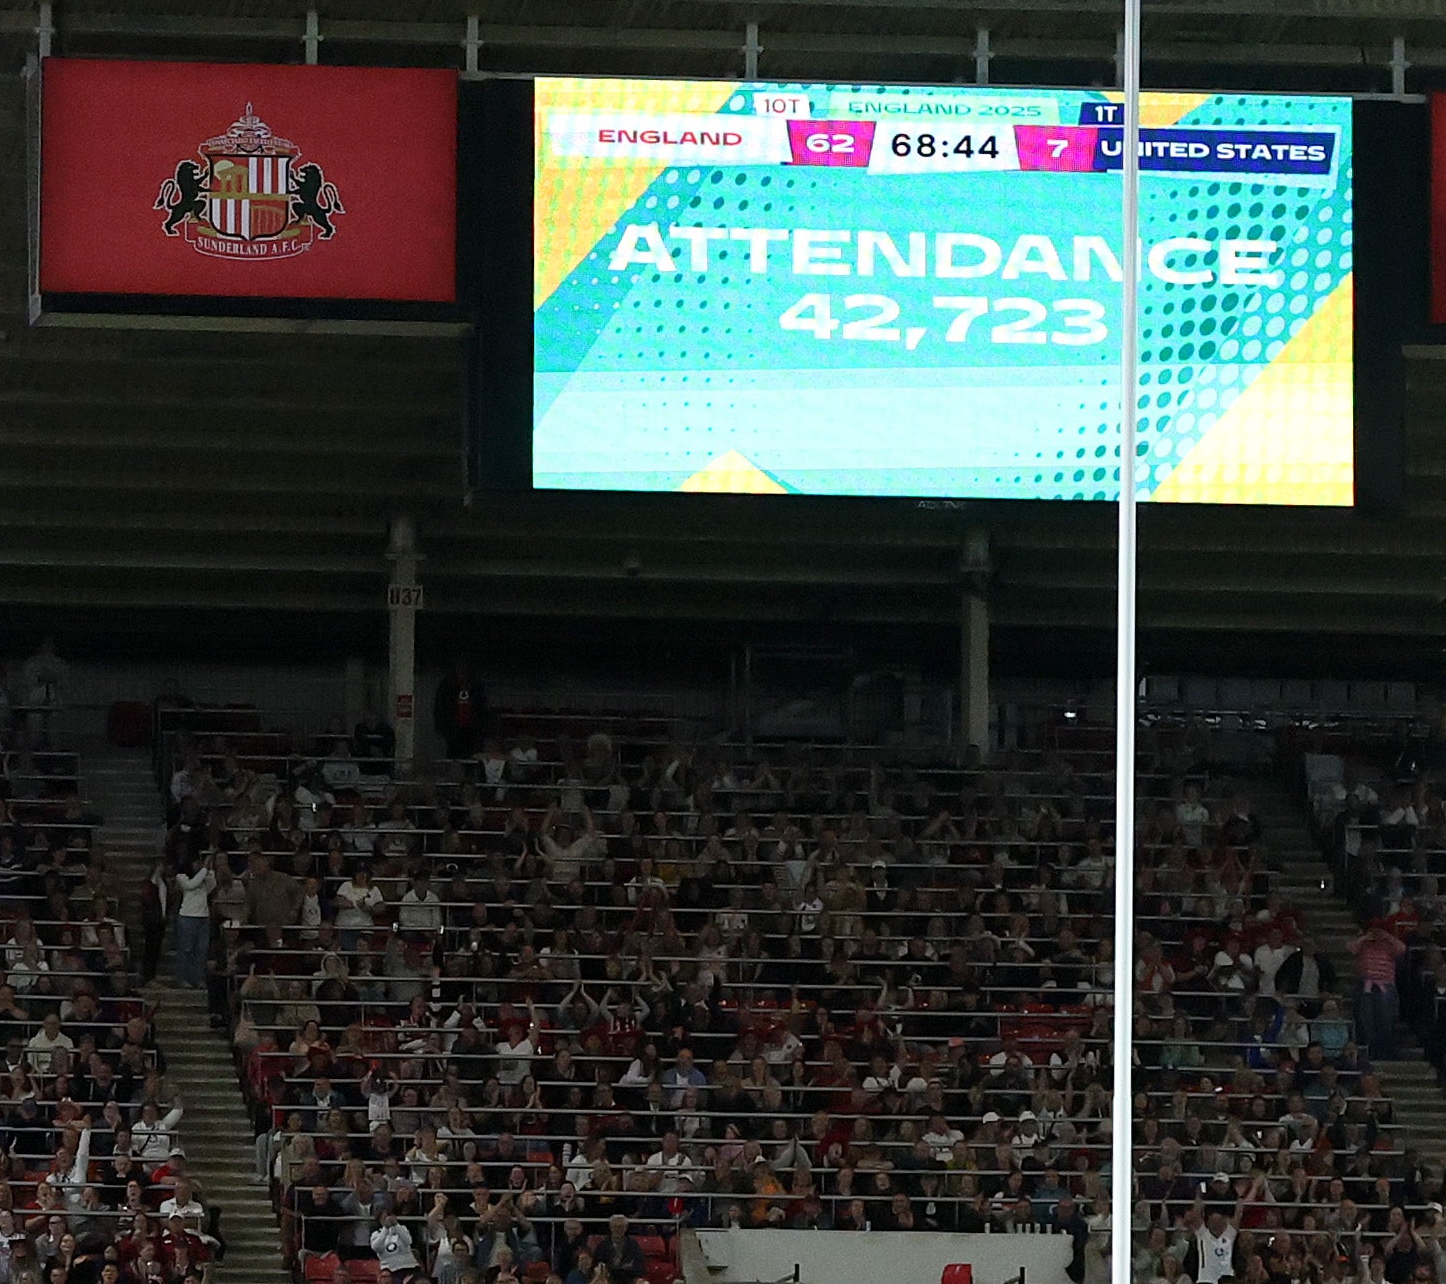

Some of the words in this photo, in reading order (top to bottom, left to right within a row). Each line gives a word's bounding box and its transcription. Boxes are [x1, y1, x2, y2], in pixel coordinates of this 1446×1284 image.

[764, 97, 800, 115] 10T
[848, 100, 972, 118] ENGLAND
[978, 103, 1043, 118] 2025
[597, 128, 742, 148] ENGLAND
[806, 134, 856, 154] 62
[891, 133, 1001, 160] 68:44
[1046, 139, 1066, 158] 7
[1216, 142, 1326, 164] STATES
[197, 236, 268, 256] SUNDERLAND
[608, 226, 1280, 287] ATTENDANCE
[778, 293, 1109, 351] 42,723
